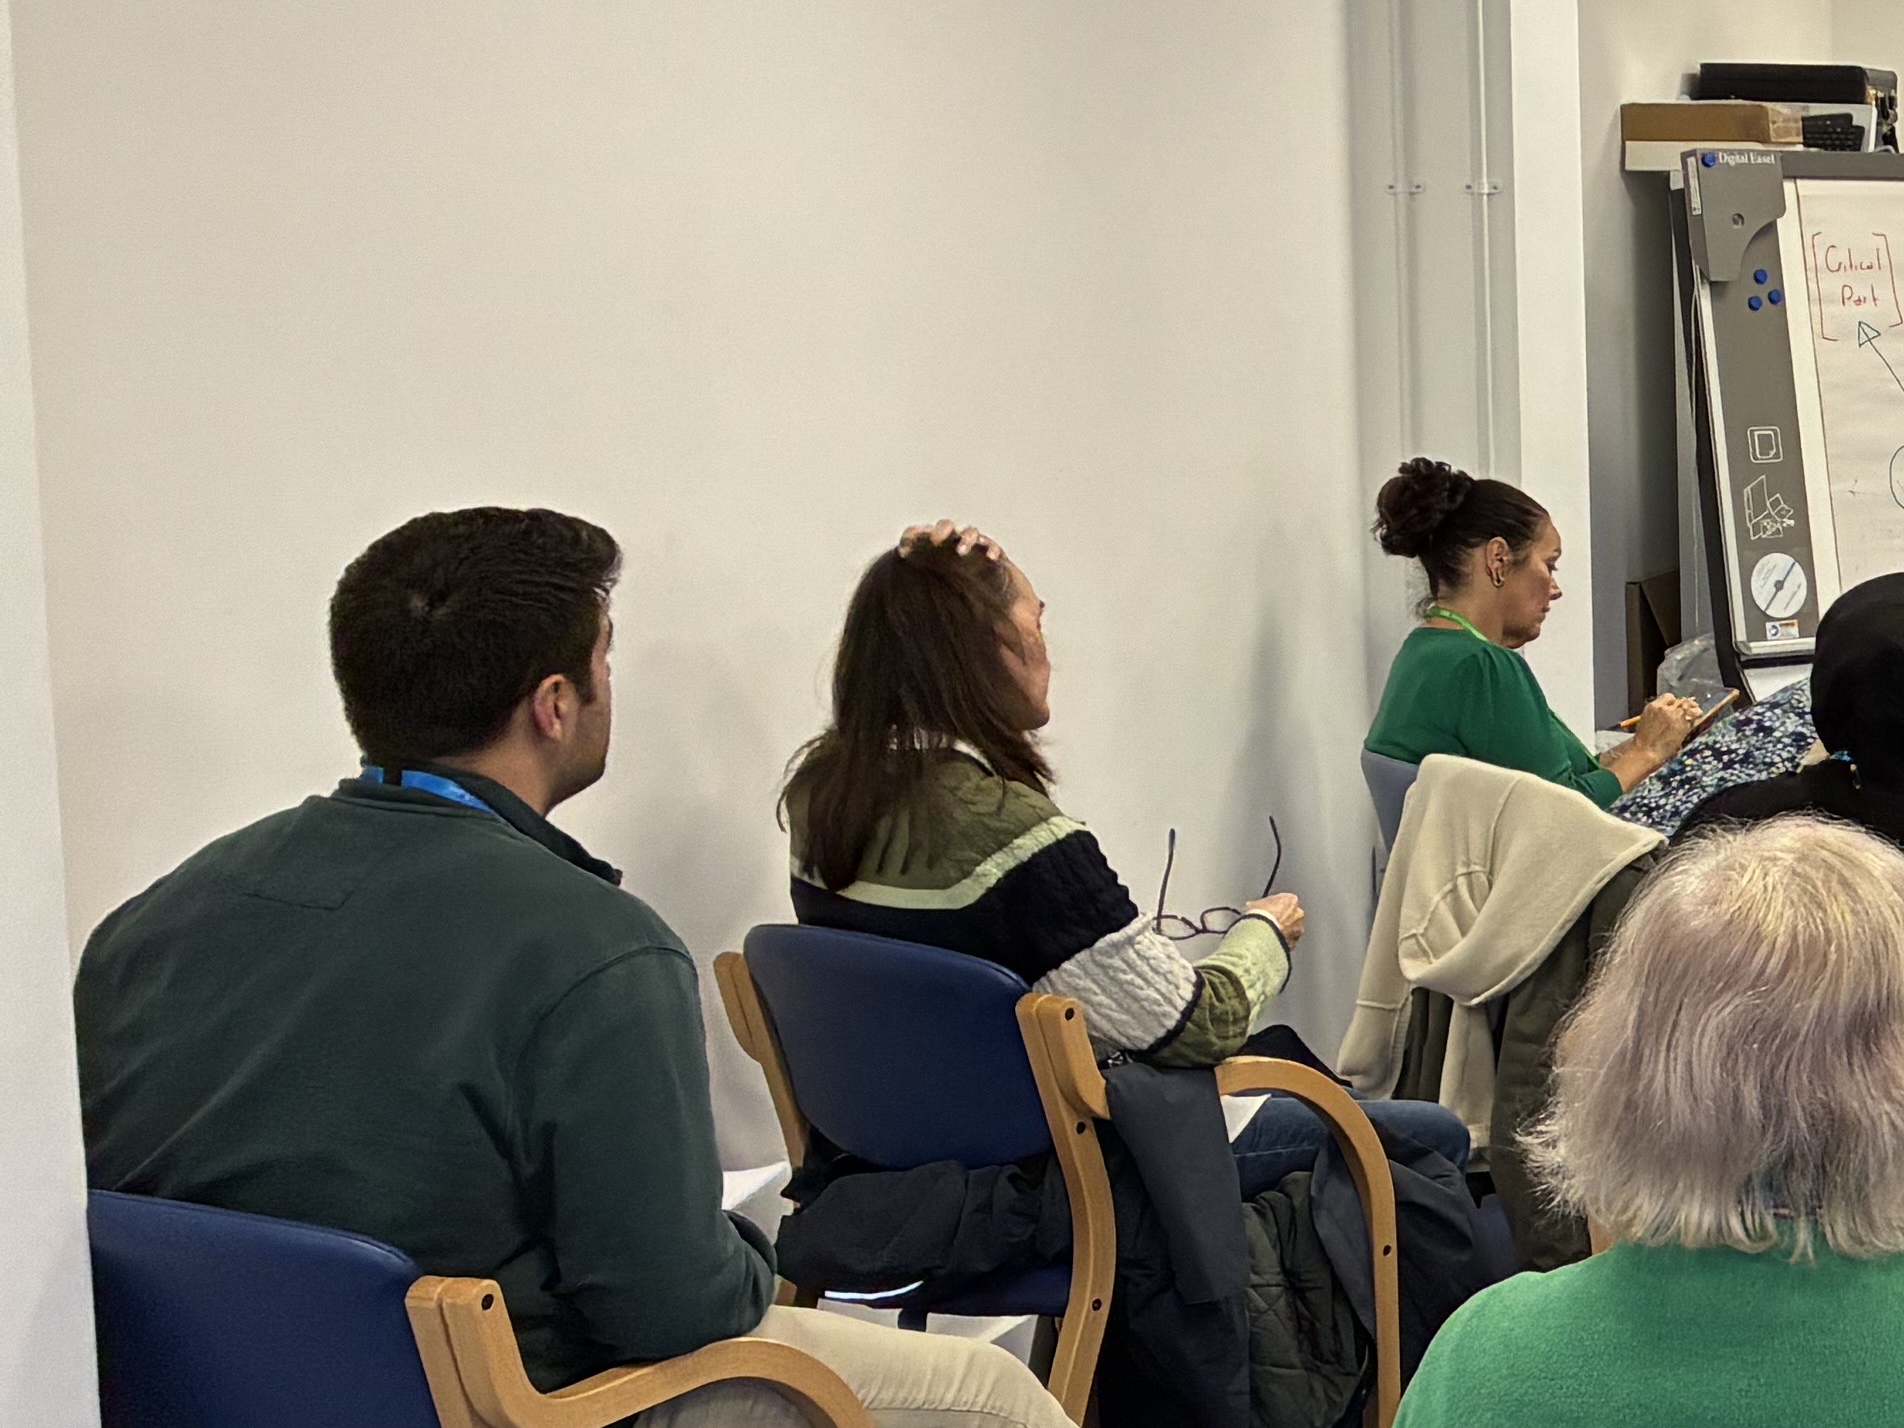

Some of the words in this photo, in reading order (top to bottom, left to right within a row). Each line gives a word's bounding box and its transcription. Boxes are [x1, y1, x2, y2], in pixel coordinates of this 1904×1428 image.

[1718, 151, 1749, 166] Digital
[1749, 151, 1776, 165] Easel
[1825, 244, 1882, 273] Critical
[1841, 283, 1880, 308] Part
